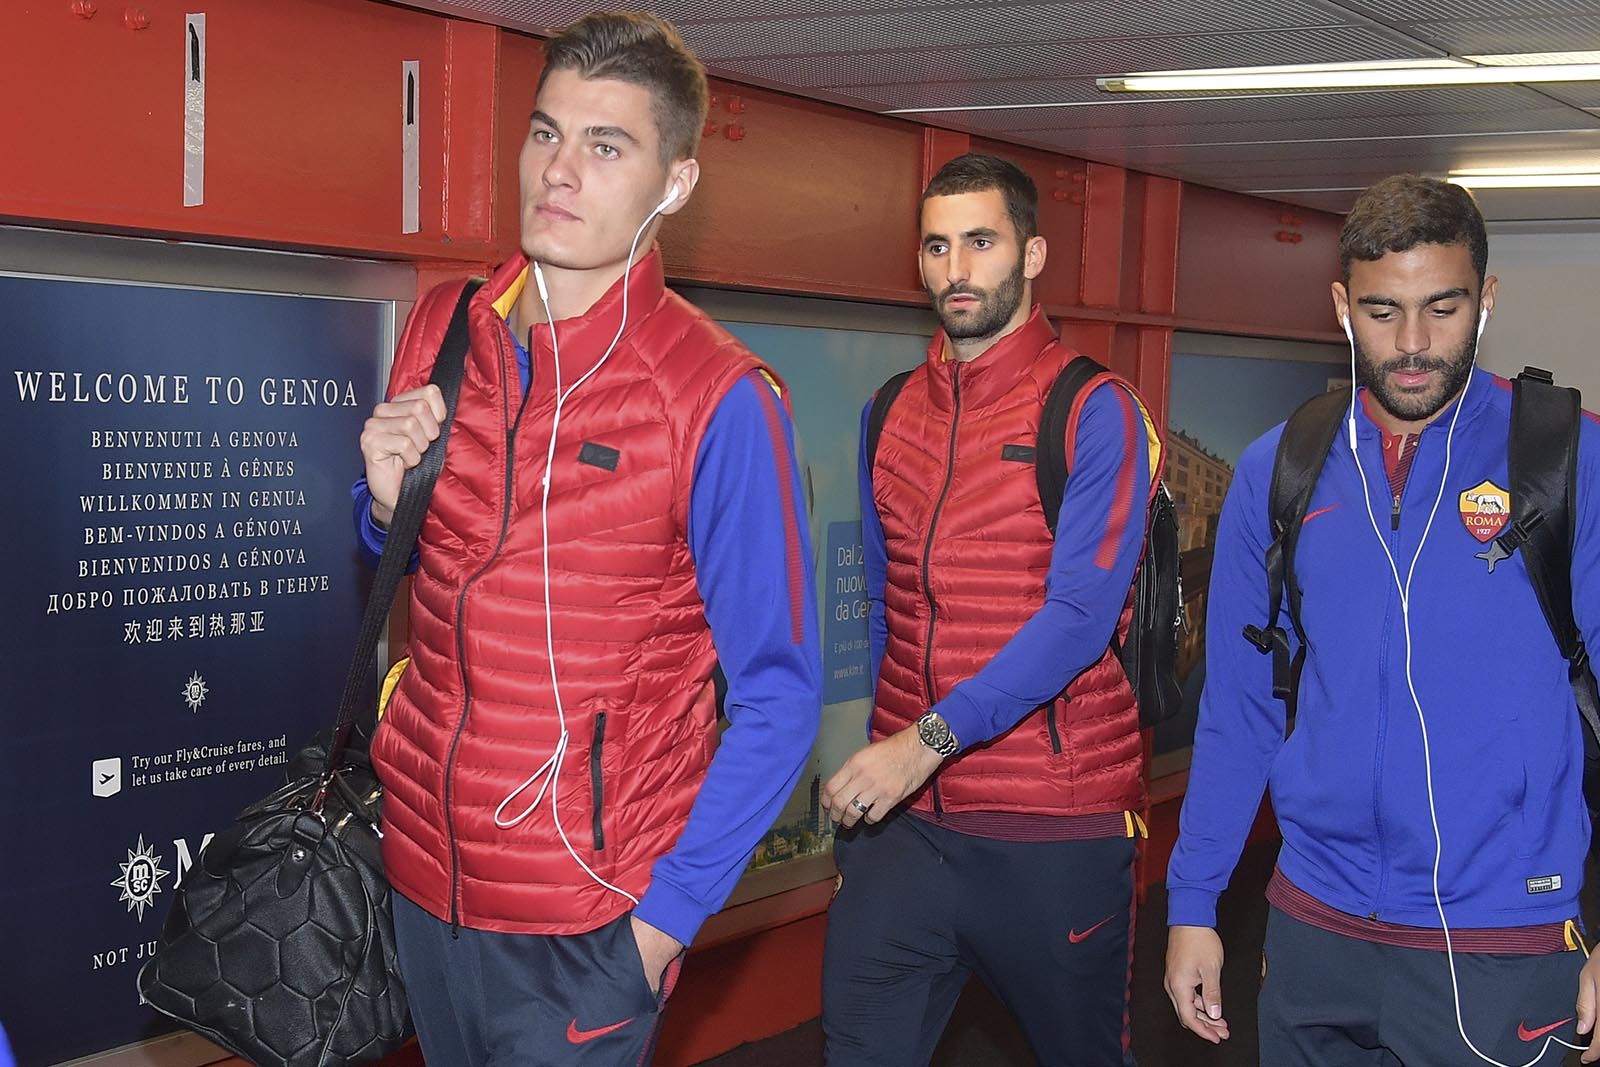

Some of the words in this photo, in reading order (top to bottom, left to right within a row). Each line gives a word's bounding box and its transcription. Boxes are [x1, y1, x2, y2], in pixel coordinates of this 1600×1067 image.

[14, 371, 189, 404] WELCOME
[205, 376, 244, 405] TO
[260, 377, 358, 407] GENOA
[91, 431, 202, 448] BENVENUTI
[210, 431, 221, 448] A
[229, 431, 298, 448] GENOVA
[102, 461, 213, 480] BIENVENUE
[220, 457, 231, 478] À
[239, 457, 295, 478] GÊNES
[79, 492, 213, 513] WILLKOMMEN
[222, 491, 241, 508] IN
[249, 490, 306, 508] GENUA
[84, 523, 207, 545] BEM-VINDOS
[214, 523, 225, 539] A
[233, 517, 302, 538] GÉNOVA
[1466, 516, 1503, 526] ROMA
[78, 553, 211, 577] BIENVENIDOS
[218, 553, 230, 569] A
[237, 547, 306, 568] GÉNOVA
[837, 544, 855, 566] Dal
[46, 590, 113, 615] ДОБРО
[123, 580, 251, 606] ПОЖАЛОВАТЬ
[260, 579, 269, 596] В
[277, 575, 329, 595] ГЕНУЕ
[835, 600, 849, 621] da
[123, 610, 265, 645] 欢迎来到热那亚
[131, 755, 150, 770] Try
[154, 754, 173, 766] our
[176, 743, 234, 763] Fly&Cruise
[237, 740, 265, 753] fares,
[268, 734, 286, 748] and
[132, 773, 147, 787] let
[150, 773, 162, 784] us
[165, 767, 188, 783] take
[190, 765, 213, 779] care
[215, 762, 227, 774] of
[228, 758, 255, 772] every
[258, 751, 289, 767] detail.
[93, 947, 129, 970] NOT
[137, 940, 157, 959] JU
